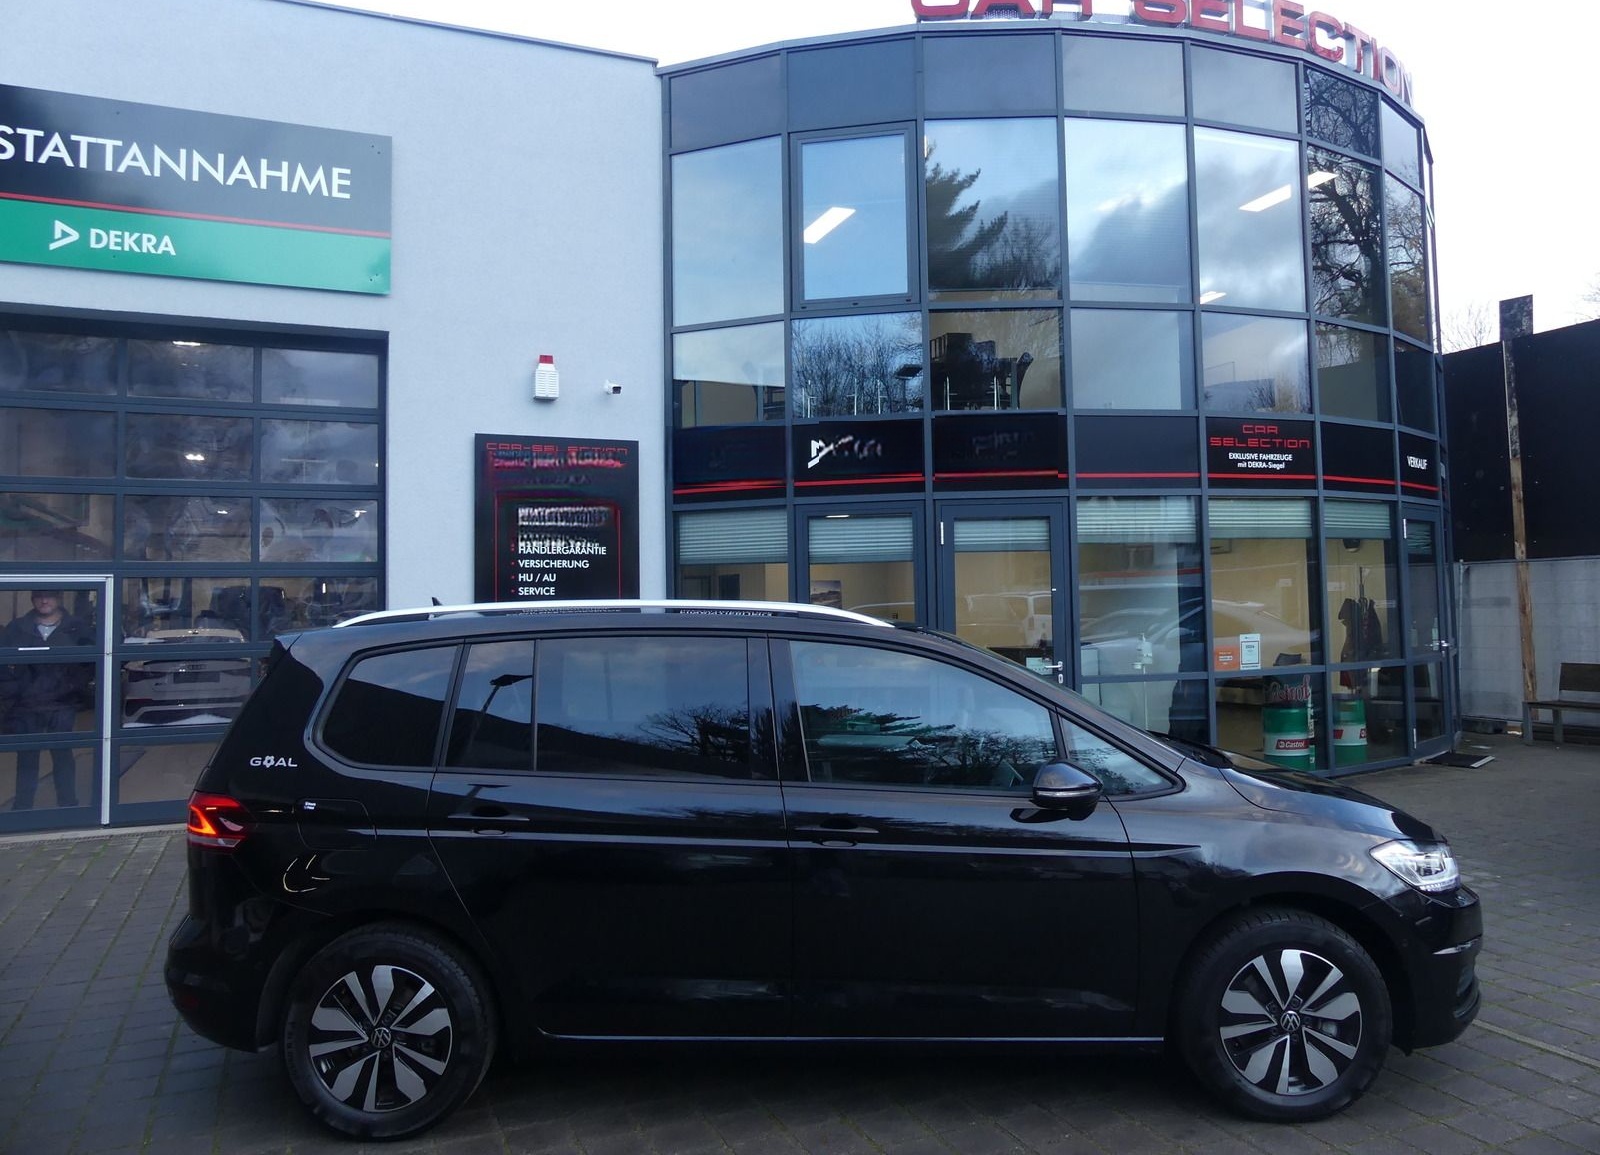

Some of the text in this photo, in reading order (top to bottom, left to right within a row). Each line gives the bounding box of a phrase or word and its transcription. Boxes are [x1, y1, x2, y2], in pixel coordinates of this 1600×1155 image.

[89, 228, 177, 255] DEKRA
[1242, 425, 1278, 434] CAR
[1209, 437, 1310, 449] SELECTION
[1228, 452, 1293, 461] EXKLUSIVE FAHRZEUGE
[1248, 461, 1285, 470] DEKRA-Siegel
[1406, 455, 1428, 470] VERKAUF
[518, 559, 590, 569] VERSICHERUNG
[518, 573, 557, 582] HU / AU
[518, 586, 556, 596] SERVICE
[1285, 741, 1305, 749] Castrol
[249, 755, 298, 768] GOAL
